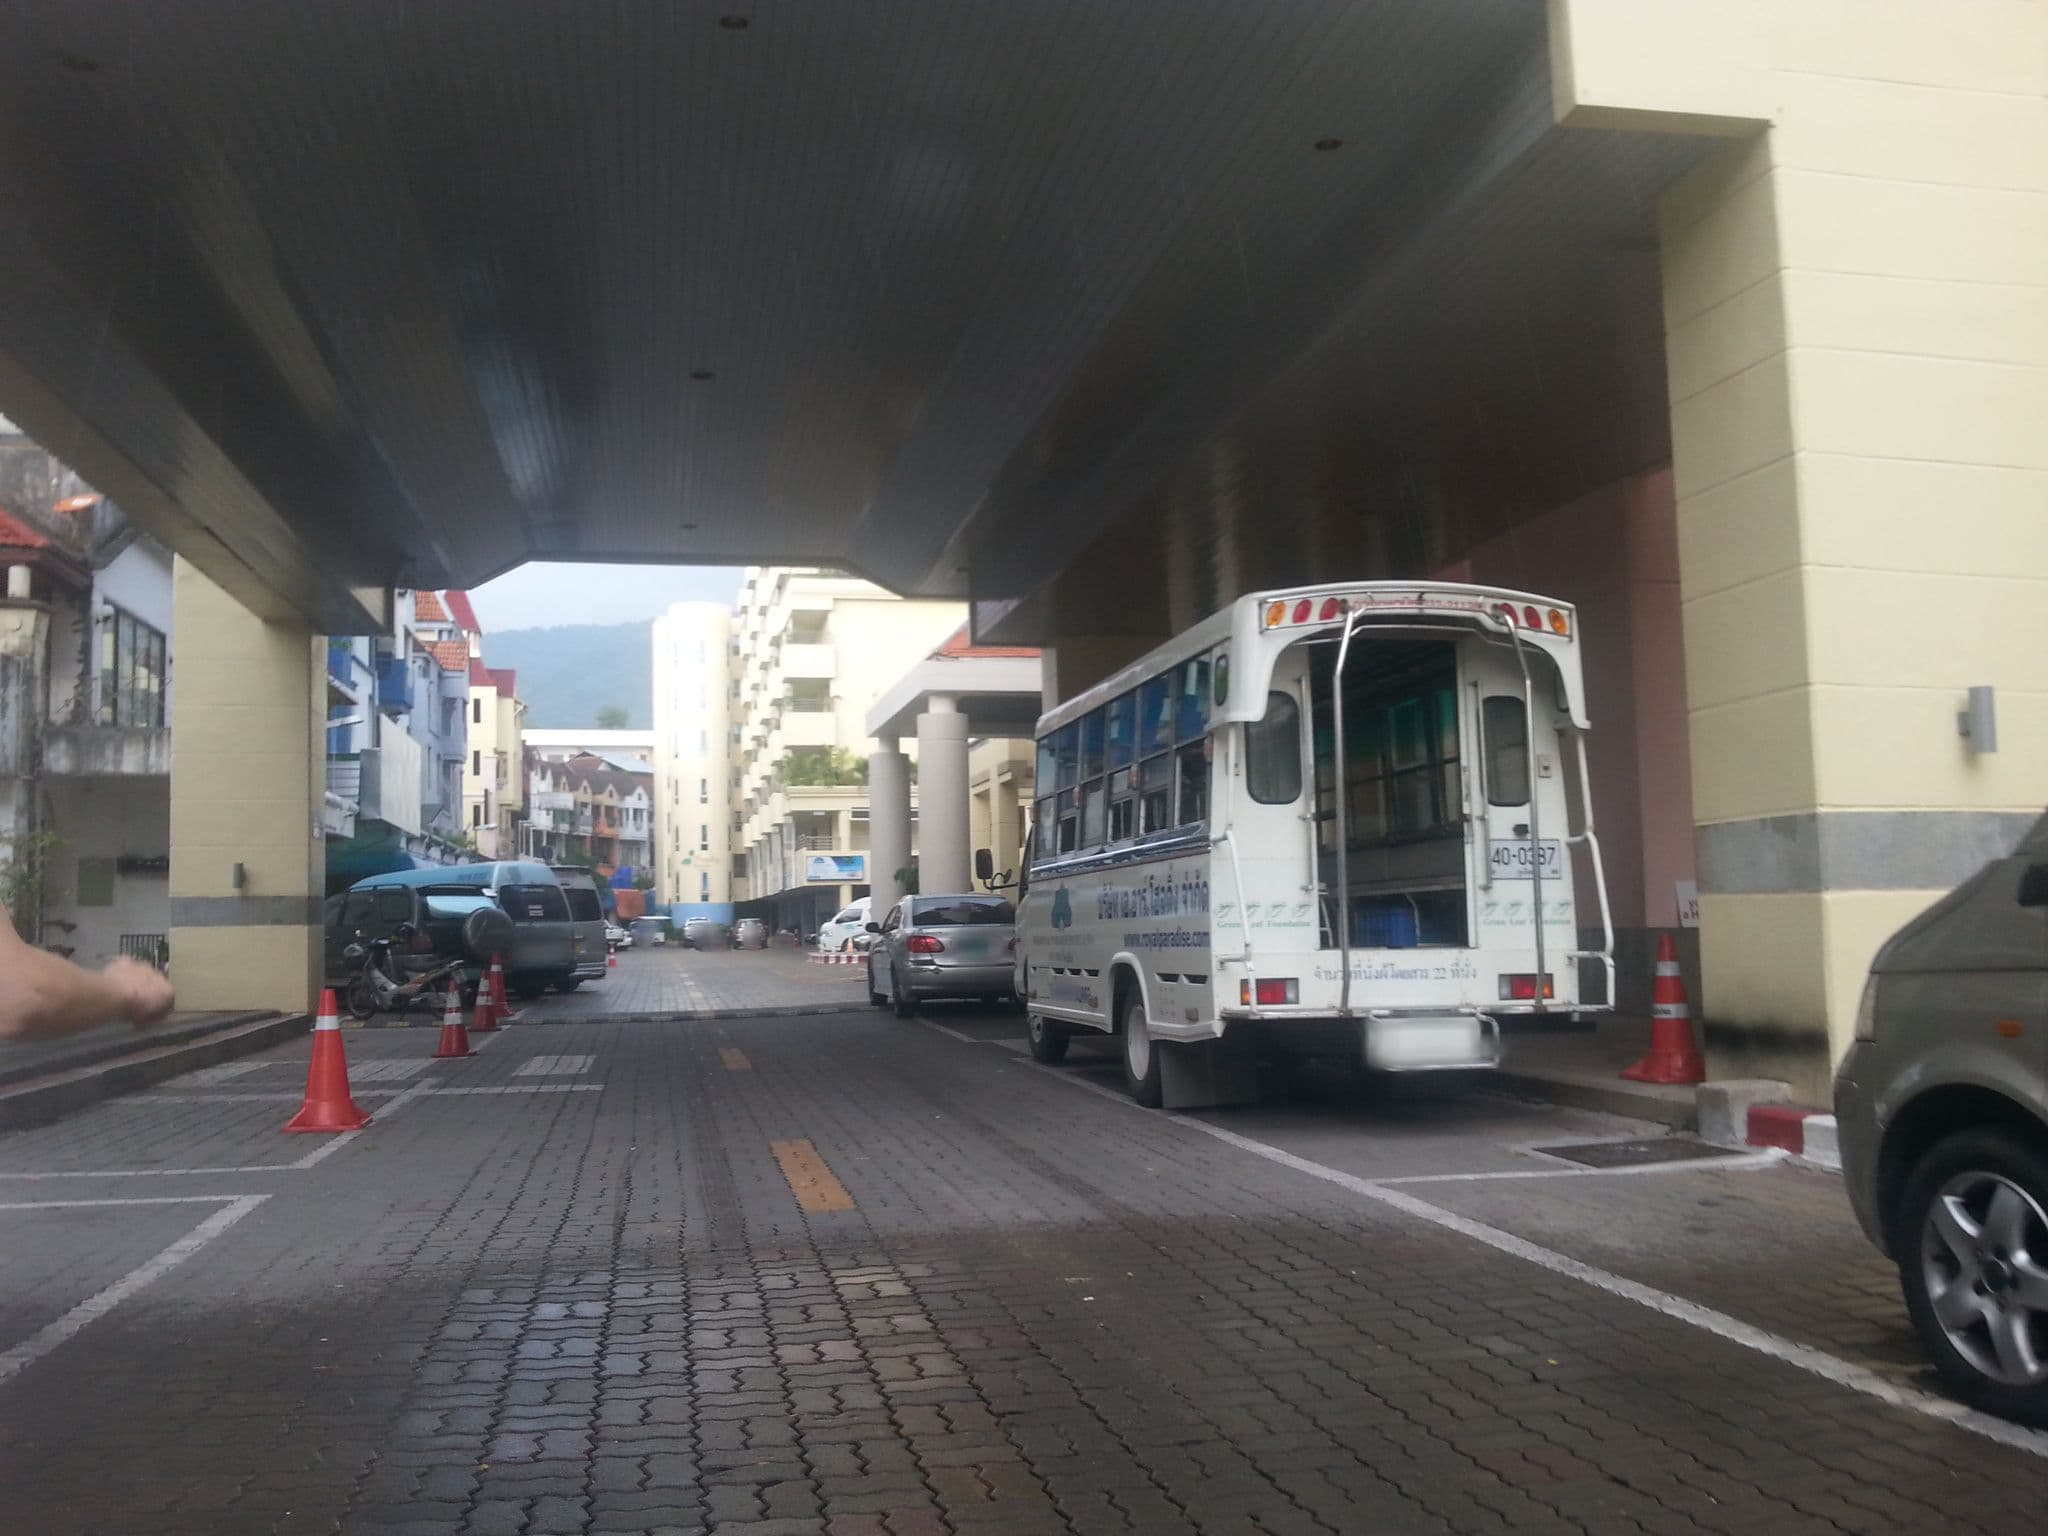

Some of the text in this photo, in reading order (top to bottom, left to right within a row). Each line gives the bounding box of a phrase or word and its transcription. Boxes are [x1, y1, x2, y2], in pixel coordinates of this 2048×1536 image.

[1182, 869, 1209, 912] จำกัด
[1124, 926, 1209, 952] www.royalparadise.com
[1433, 967, 1447, 980] 22
